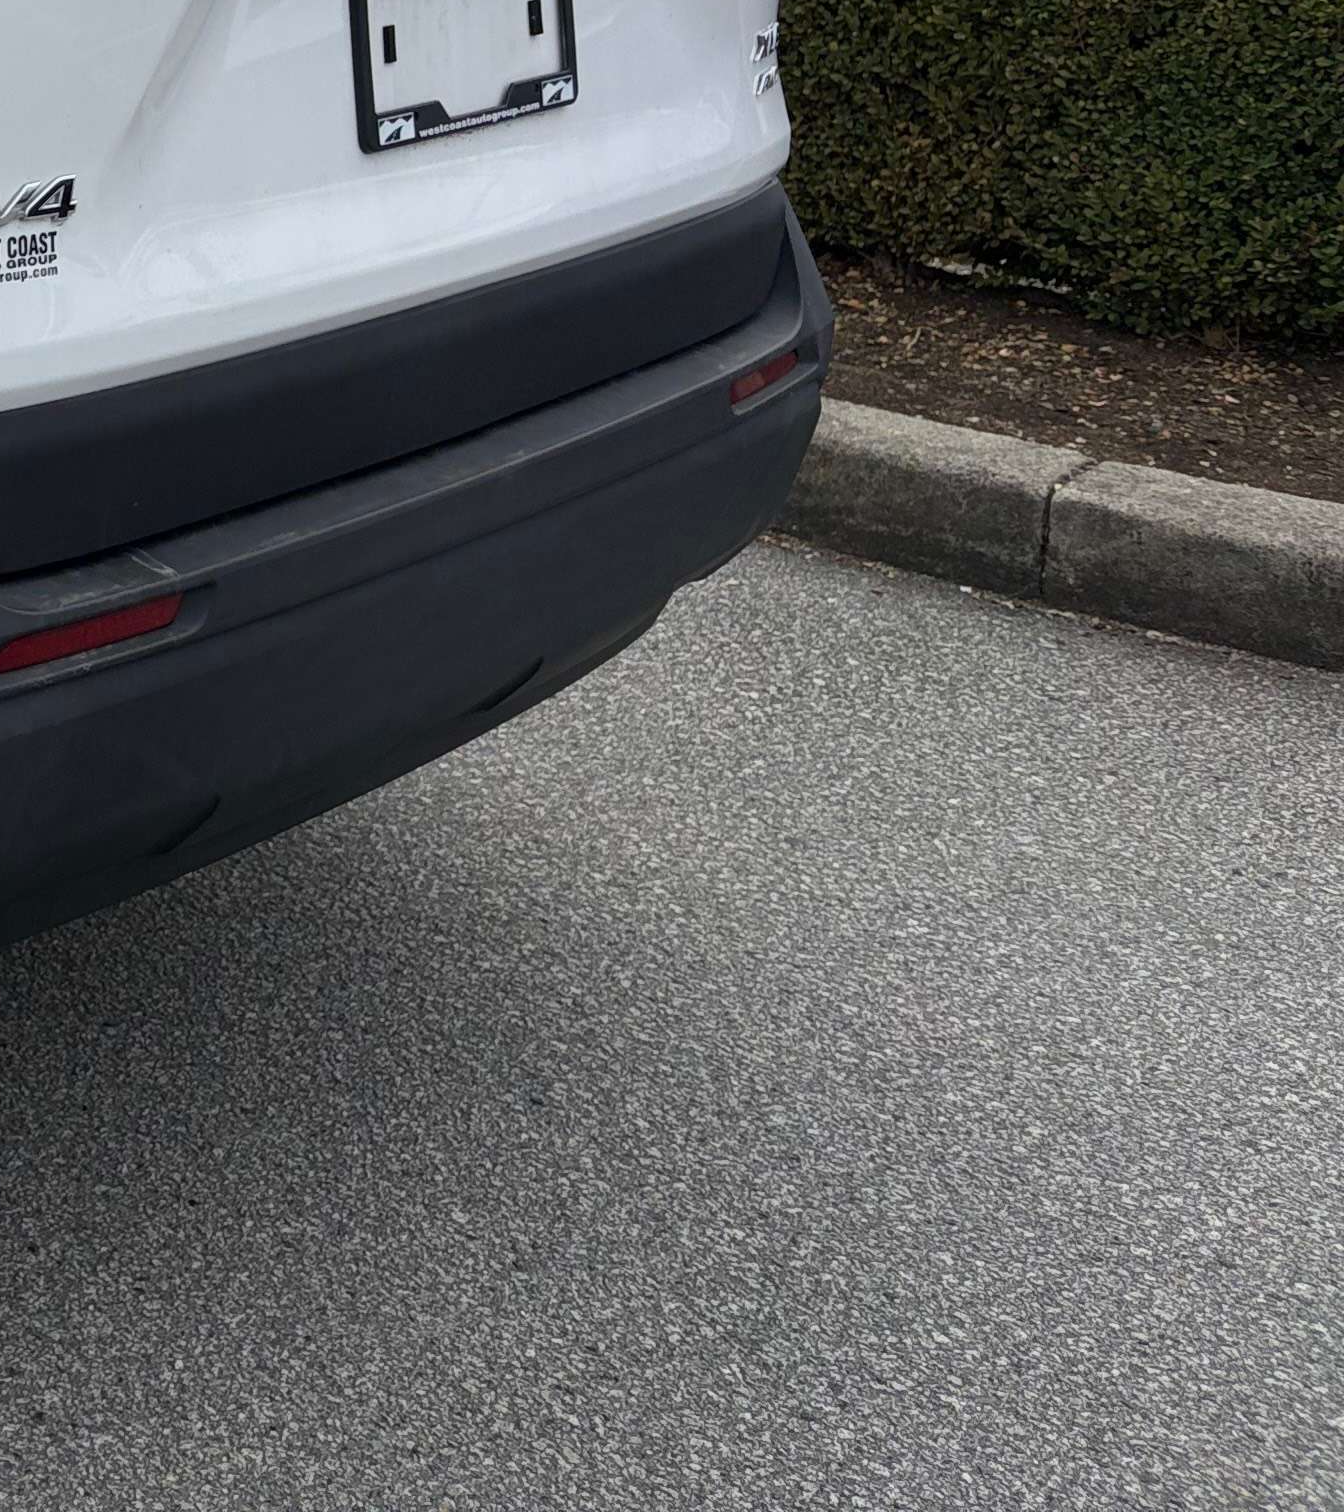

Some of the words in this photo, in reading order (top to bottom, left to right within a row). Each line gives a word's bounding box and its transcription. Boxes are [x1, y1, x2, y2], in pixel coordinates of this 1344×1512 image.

[418, 101, 541, 139] westcoastautogroup.com
[6, 230, 58, 259] COAST
[5, 253, 58, 270] GROUP
